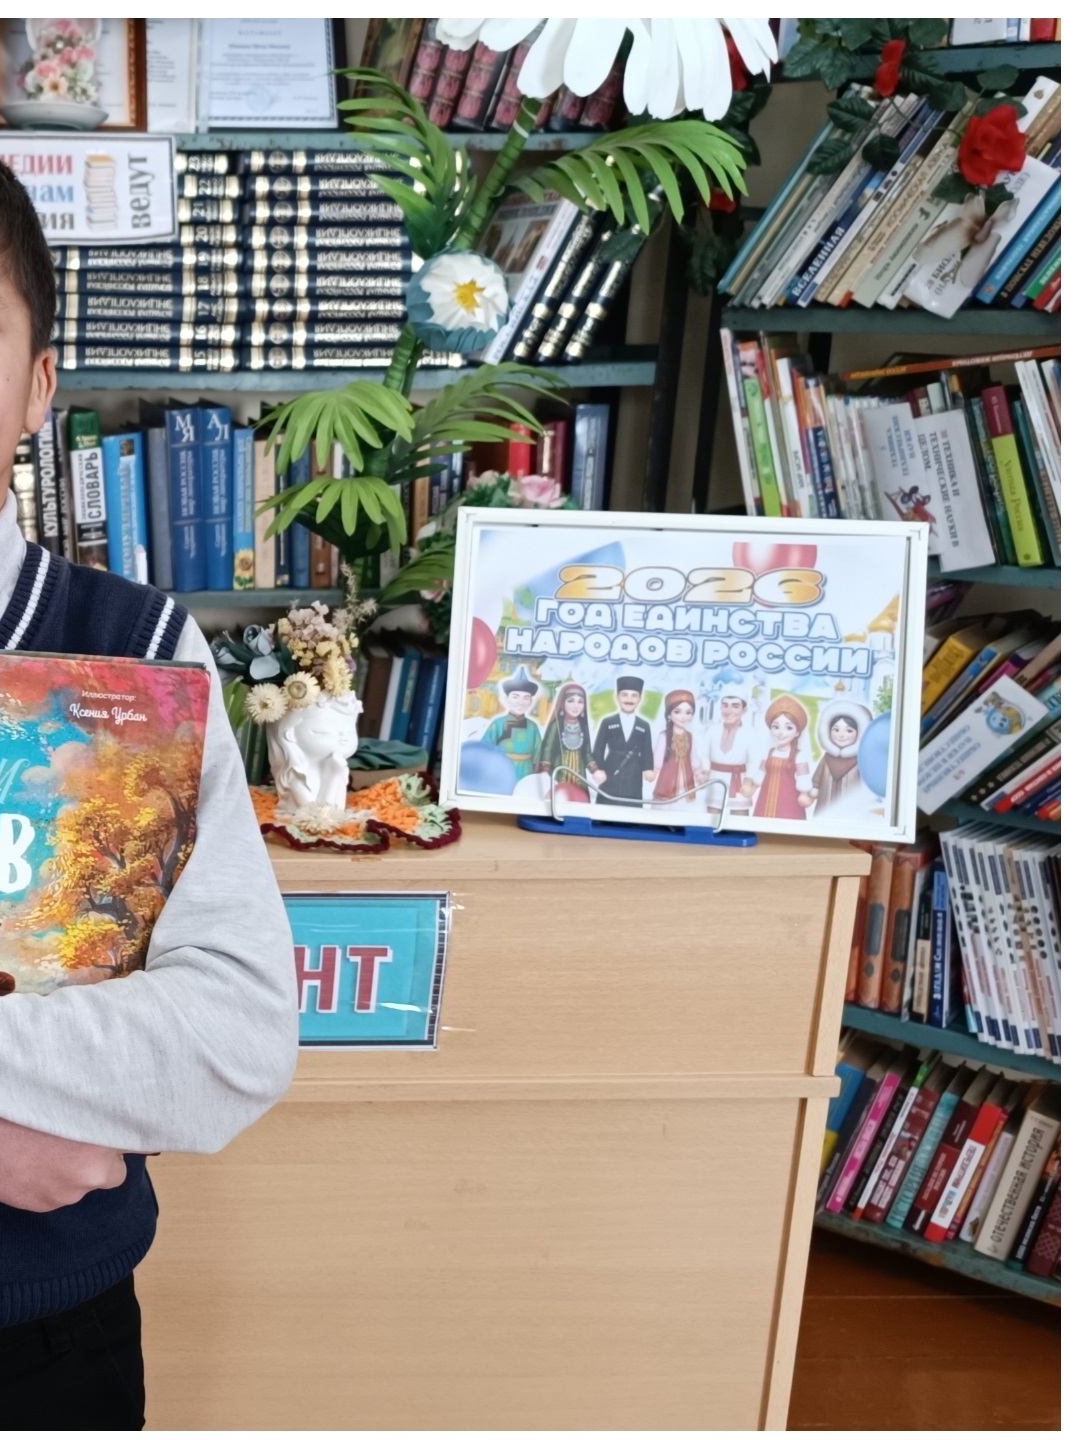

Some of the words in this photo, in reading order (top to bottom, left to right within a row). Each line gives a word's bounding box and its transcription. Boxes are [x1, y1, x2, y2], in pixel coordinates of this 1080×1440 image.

[128, 152, 155, 228] ведут
[789, 224, 847, 297] ВСЕЛЕННАЯ
[37, 421, 59, 537] КУЛЬТУРОЛОГИЯ
[85, 452, 101, 519] СЛОВАРЬ
[927, 431, 950, 503] ТЕХНИЧЕСКИЕ
[941, 440, 958, 487] ТЕХНИКА
[943, 504, 958, 539] НАУКИ
[950, 539, 959, 547] В
[554, 564, 826, 607] 2026
[535, 598, 617, 630] ГОД
[621, 603, 841, 643] ЕДИНСТВА
[505, 626, 697, 666] НАРОДОВ
[702, 638, 873, 678] РОССИИ
[69, 703, 109, 720] Ксения
[110, 707, 147, 726] Урбан
[82, 690, 137, 702] Иллюстратор:
